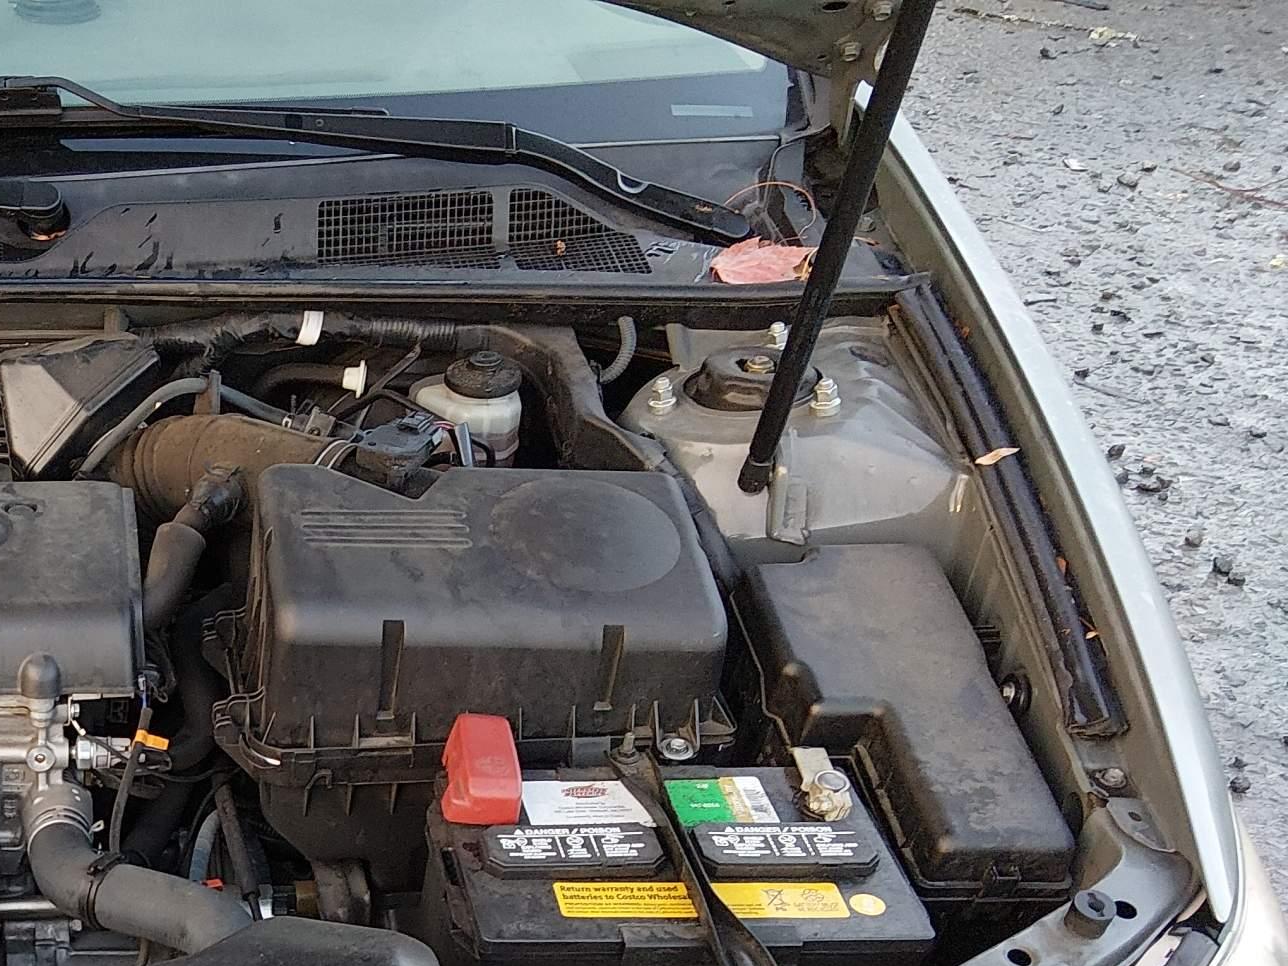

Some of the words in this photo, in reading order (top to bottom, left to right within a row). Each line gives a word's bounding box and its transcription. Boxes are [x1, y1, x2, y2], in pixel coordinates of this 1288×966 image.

[593, 885, 634, 893] warranty
[637, 884, 654, 892] and
[656, 884, 679, 892] used
